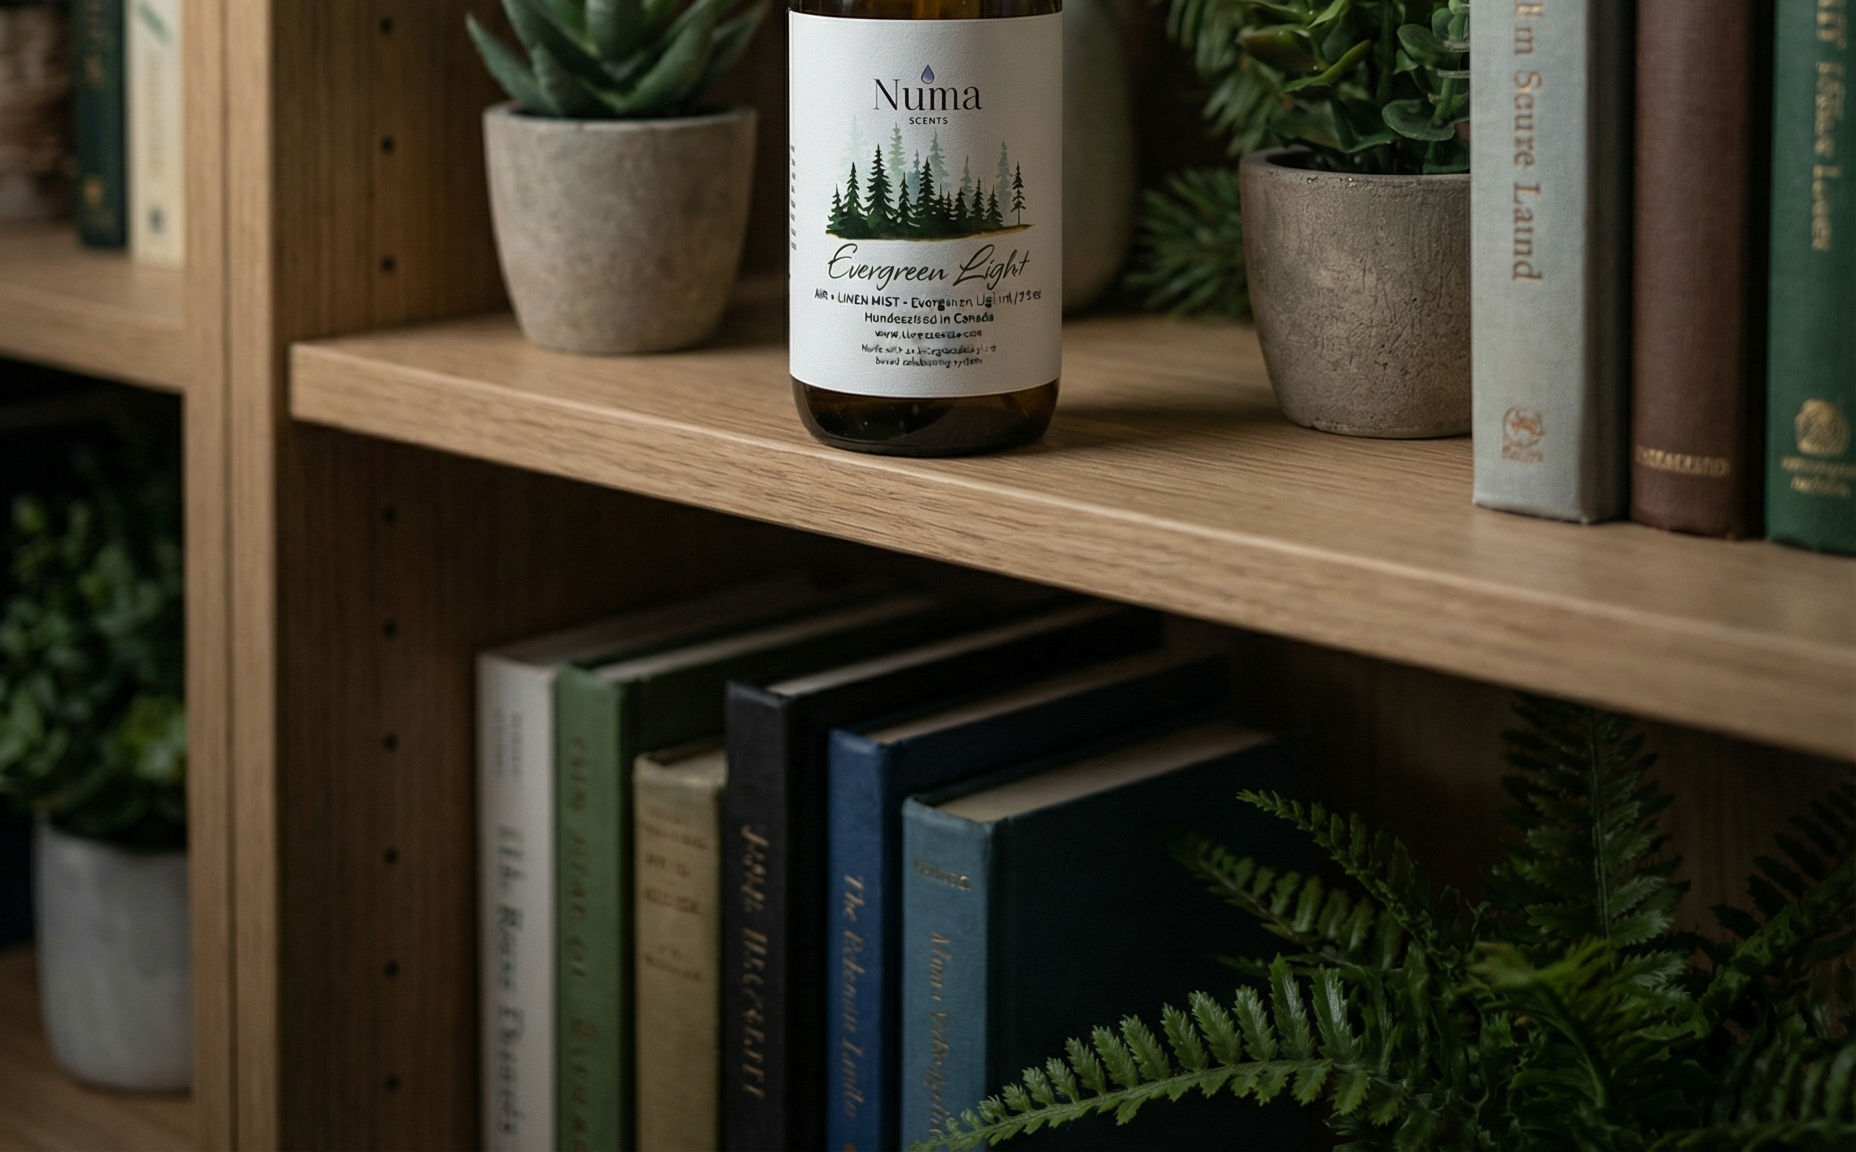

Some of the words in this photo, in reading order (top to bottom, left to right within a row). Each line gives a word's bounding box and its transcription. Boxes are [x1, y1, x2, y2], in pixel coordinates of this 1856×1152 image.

[873, 77, 982, 111] Numa
[908, 116, 948, 125] SCENTS
[827, 243, 948, 291] Evergreen
[952, 244, 1030, 290] Light
[871, 295, 900, 308] MIST
